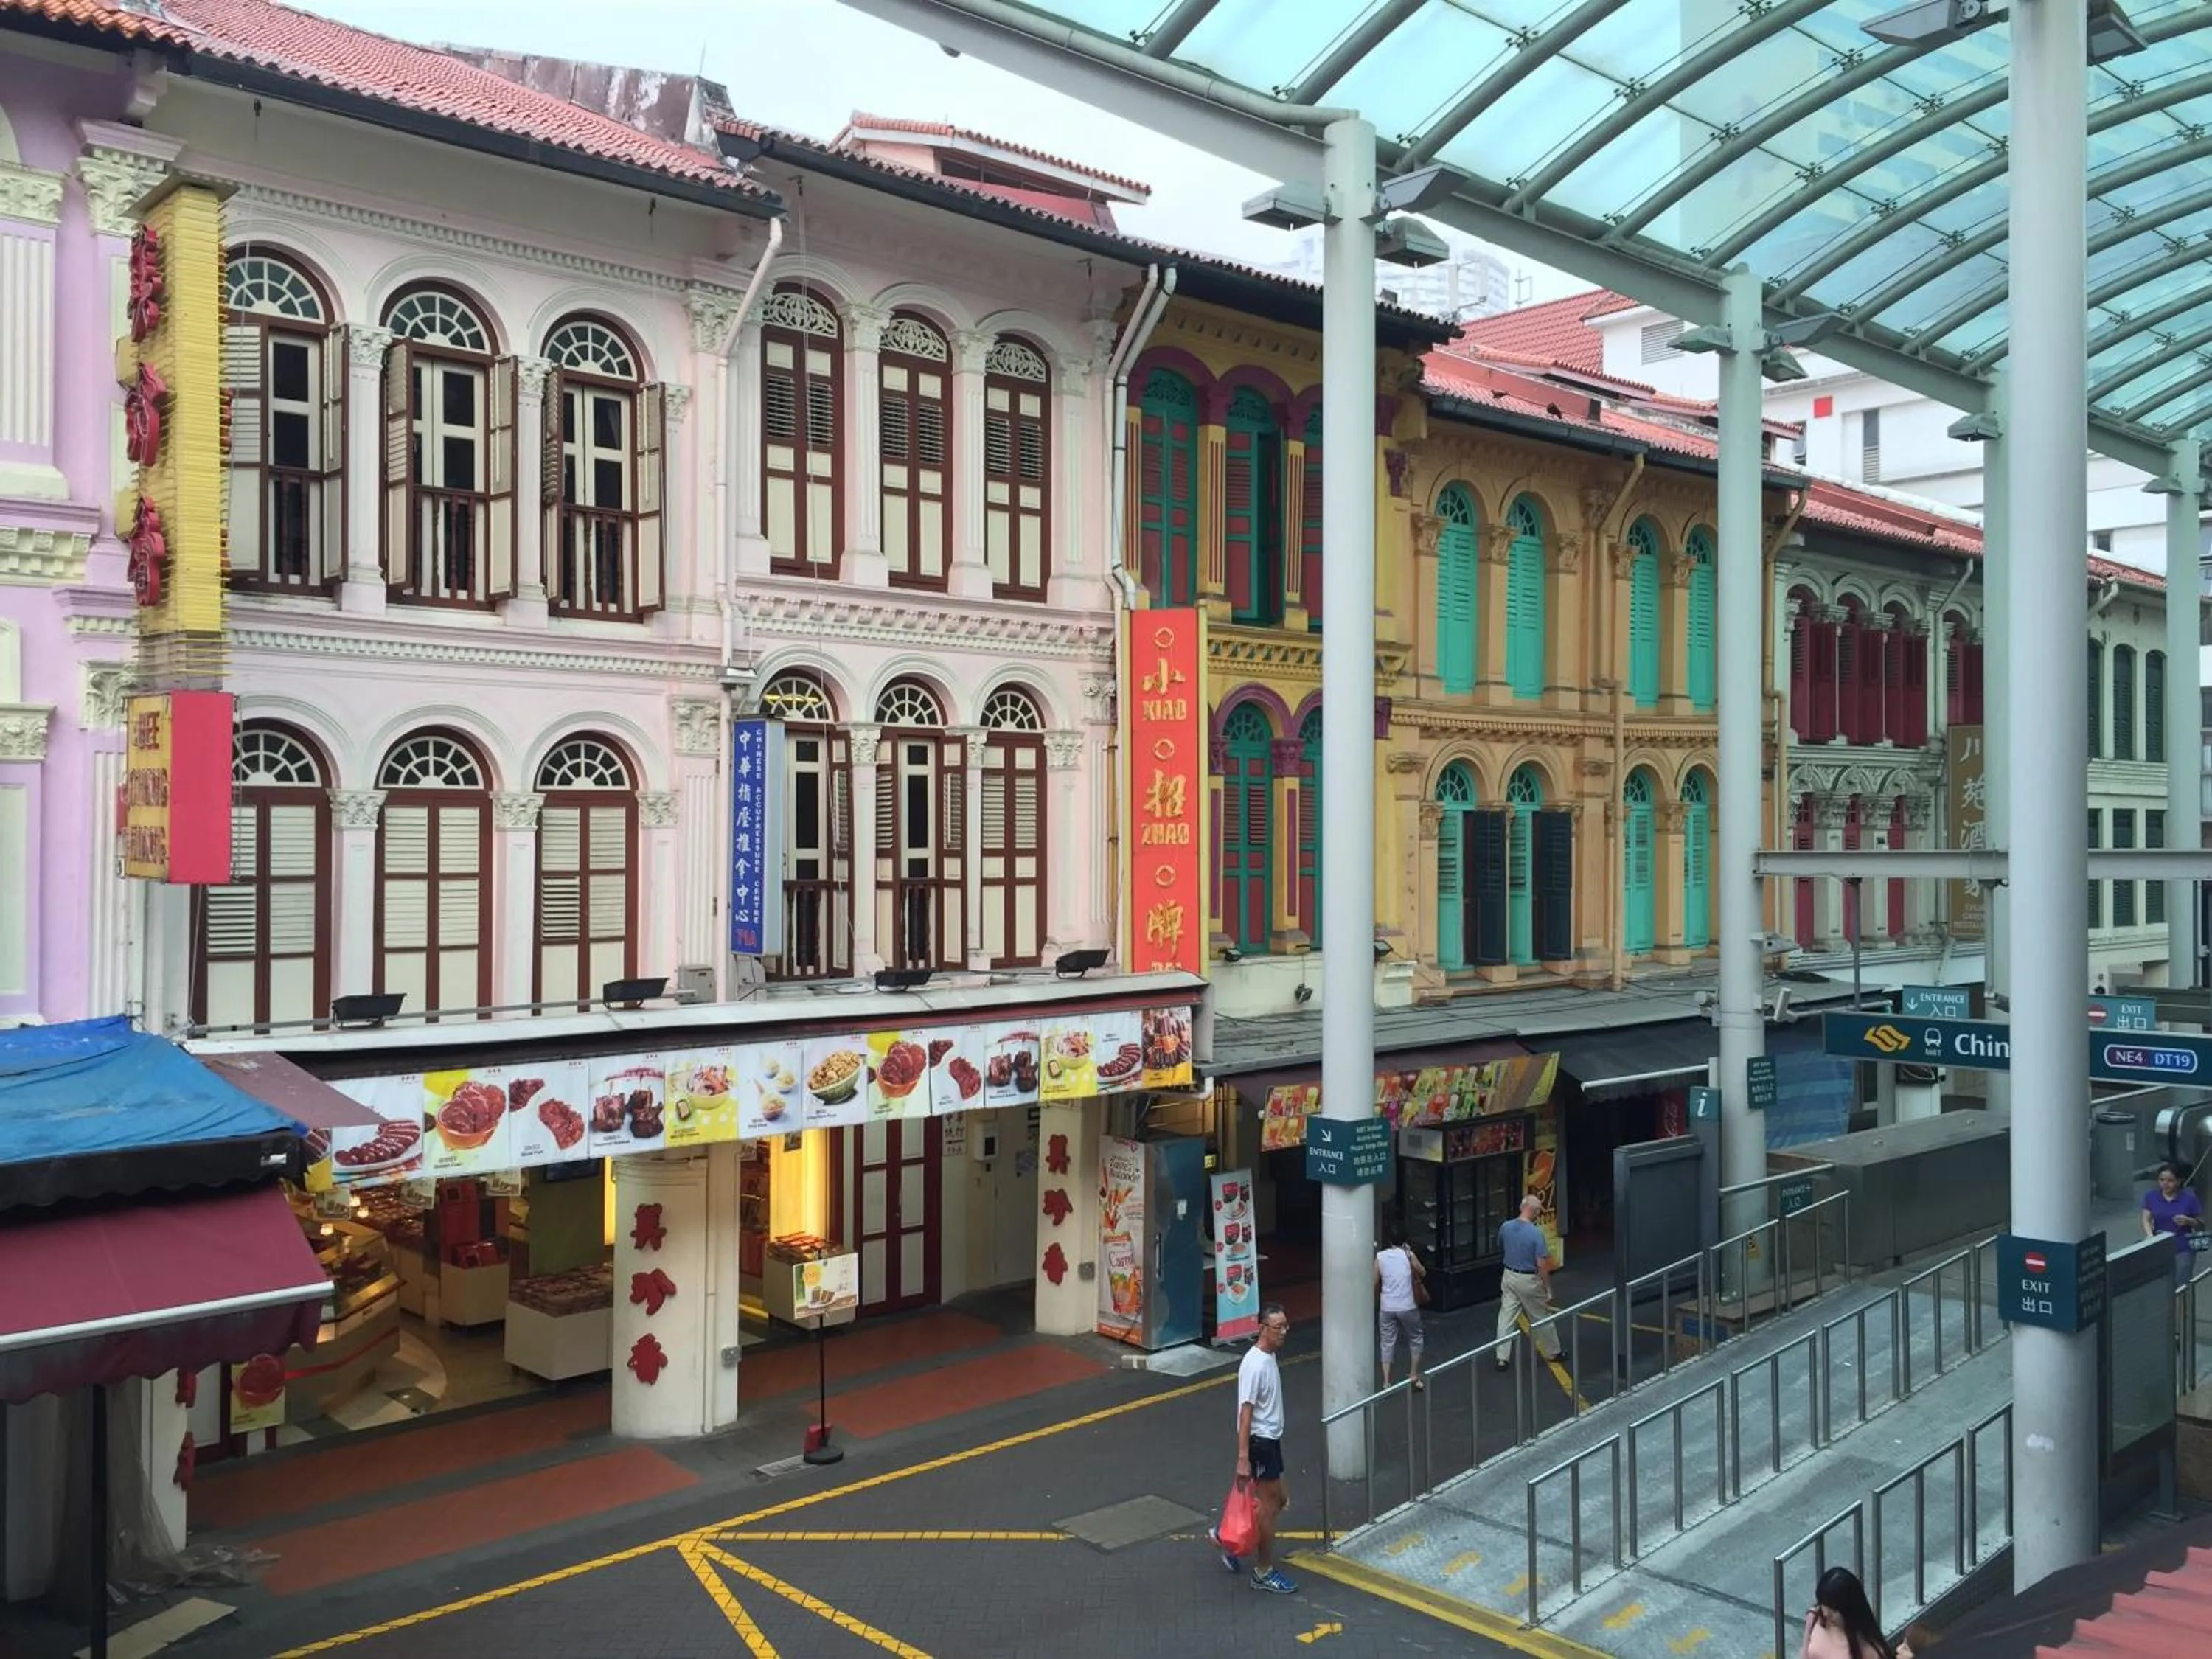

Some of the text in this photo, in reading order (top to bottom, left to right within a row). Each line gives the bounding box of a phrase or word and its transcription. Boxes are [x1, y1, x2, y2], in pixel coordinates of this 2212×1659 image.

[1142, 658, 1186, 694] 小
[1143, 699, 1187, 720] XIAO
[1142, 822, 1189, 844] ZHAO
[1920, 992, 1965, 1004] ENTRANCE
[1930, 1004, 1956, 1017] 入口
[2121, 1004, 2143, 1015] EXIT
[2117, 1015, 2147, 1030] 出口
[2115, 1050, 2191, 1066] NE4 DT19
[1309, 1147, 1344, 1161] ENTRANCE
[1318, 1163, 1336, 1174] 入口
[2022, 1279, 2051, 1294] EXIT
[2022, 1296, 2053, 1315] 出口
